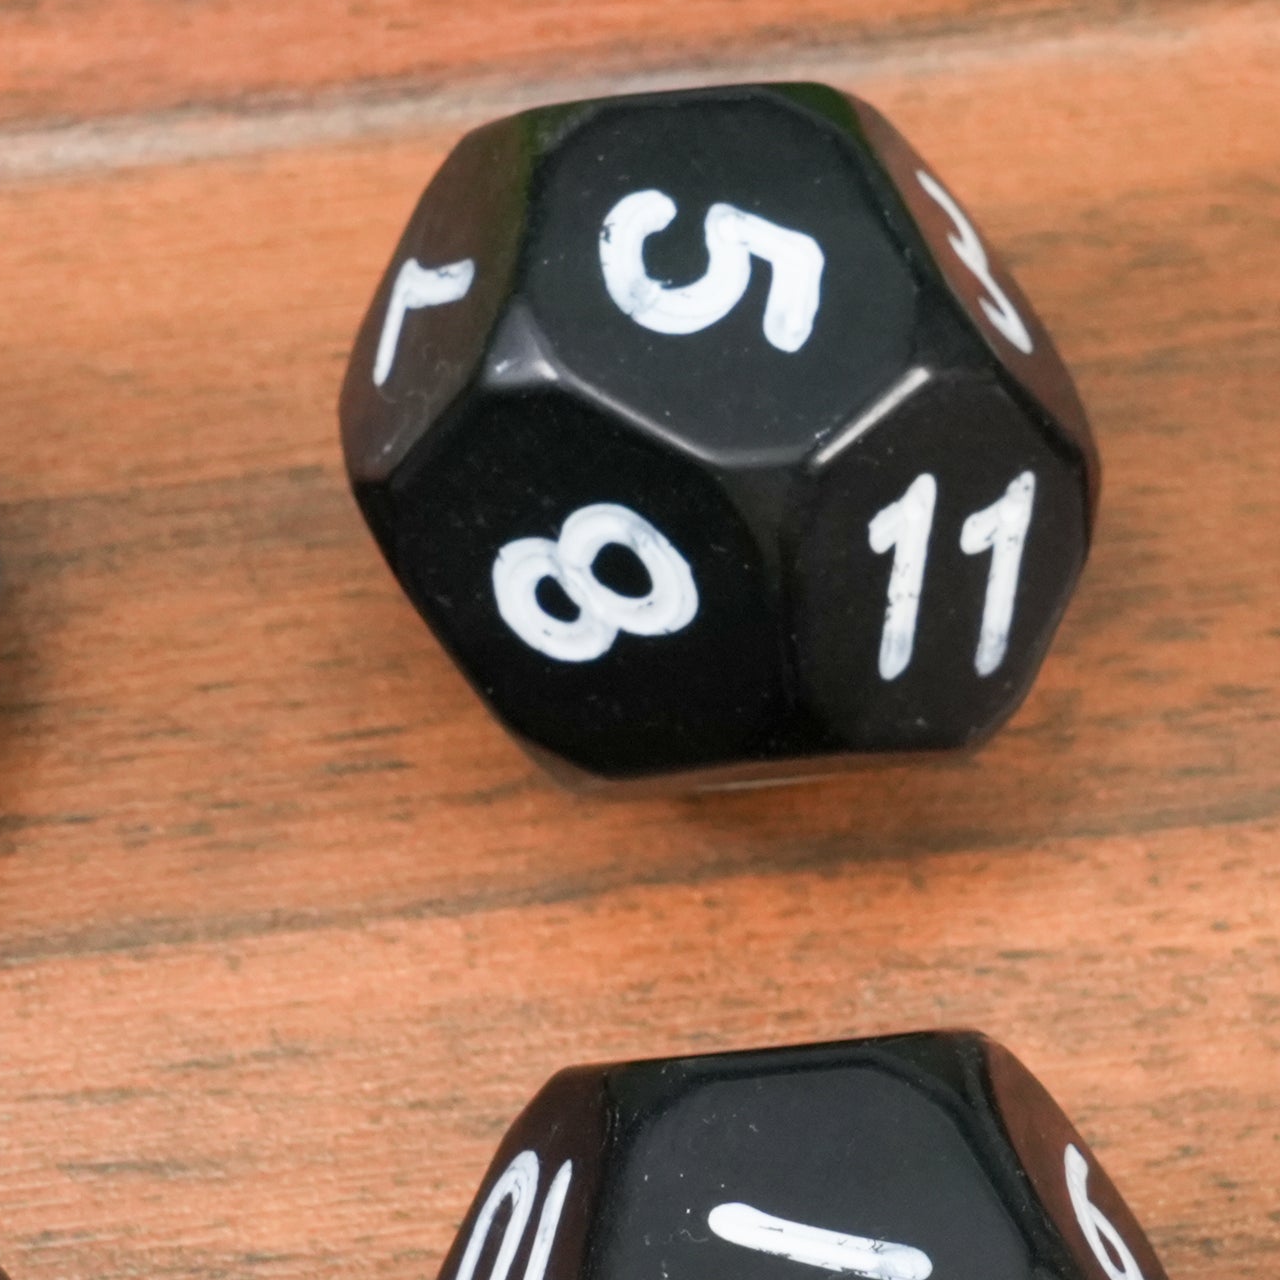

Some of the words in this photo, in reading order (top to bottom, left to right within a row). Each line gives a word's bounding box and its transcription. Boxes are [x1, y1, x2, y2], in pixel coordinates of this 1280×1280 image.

[597, 187, 826, 354] 5
[491, 502, 700, 663] 8
[867, 470, 1035, 681] 11
